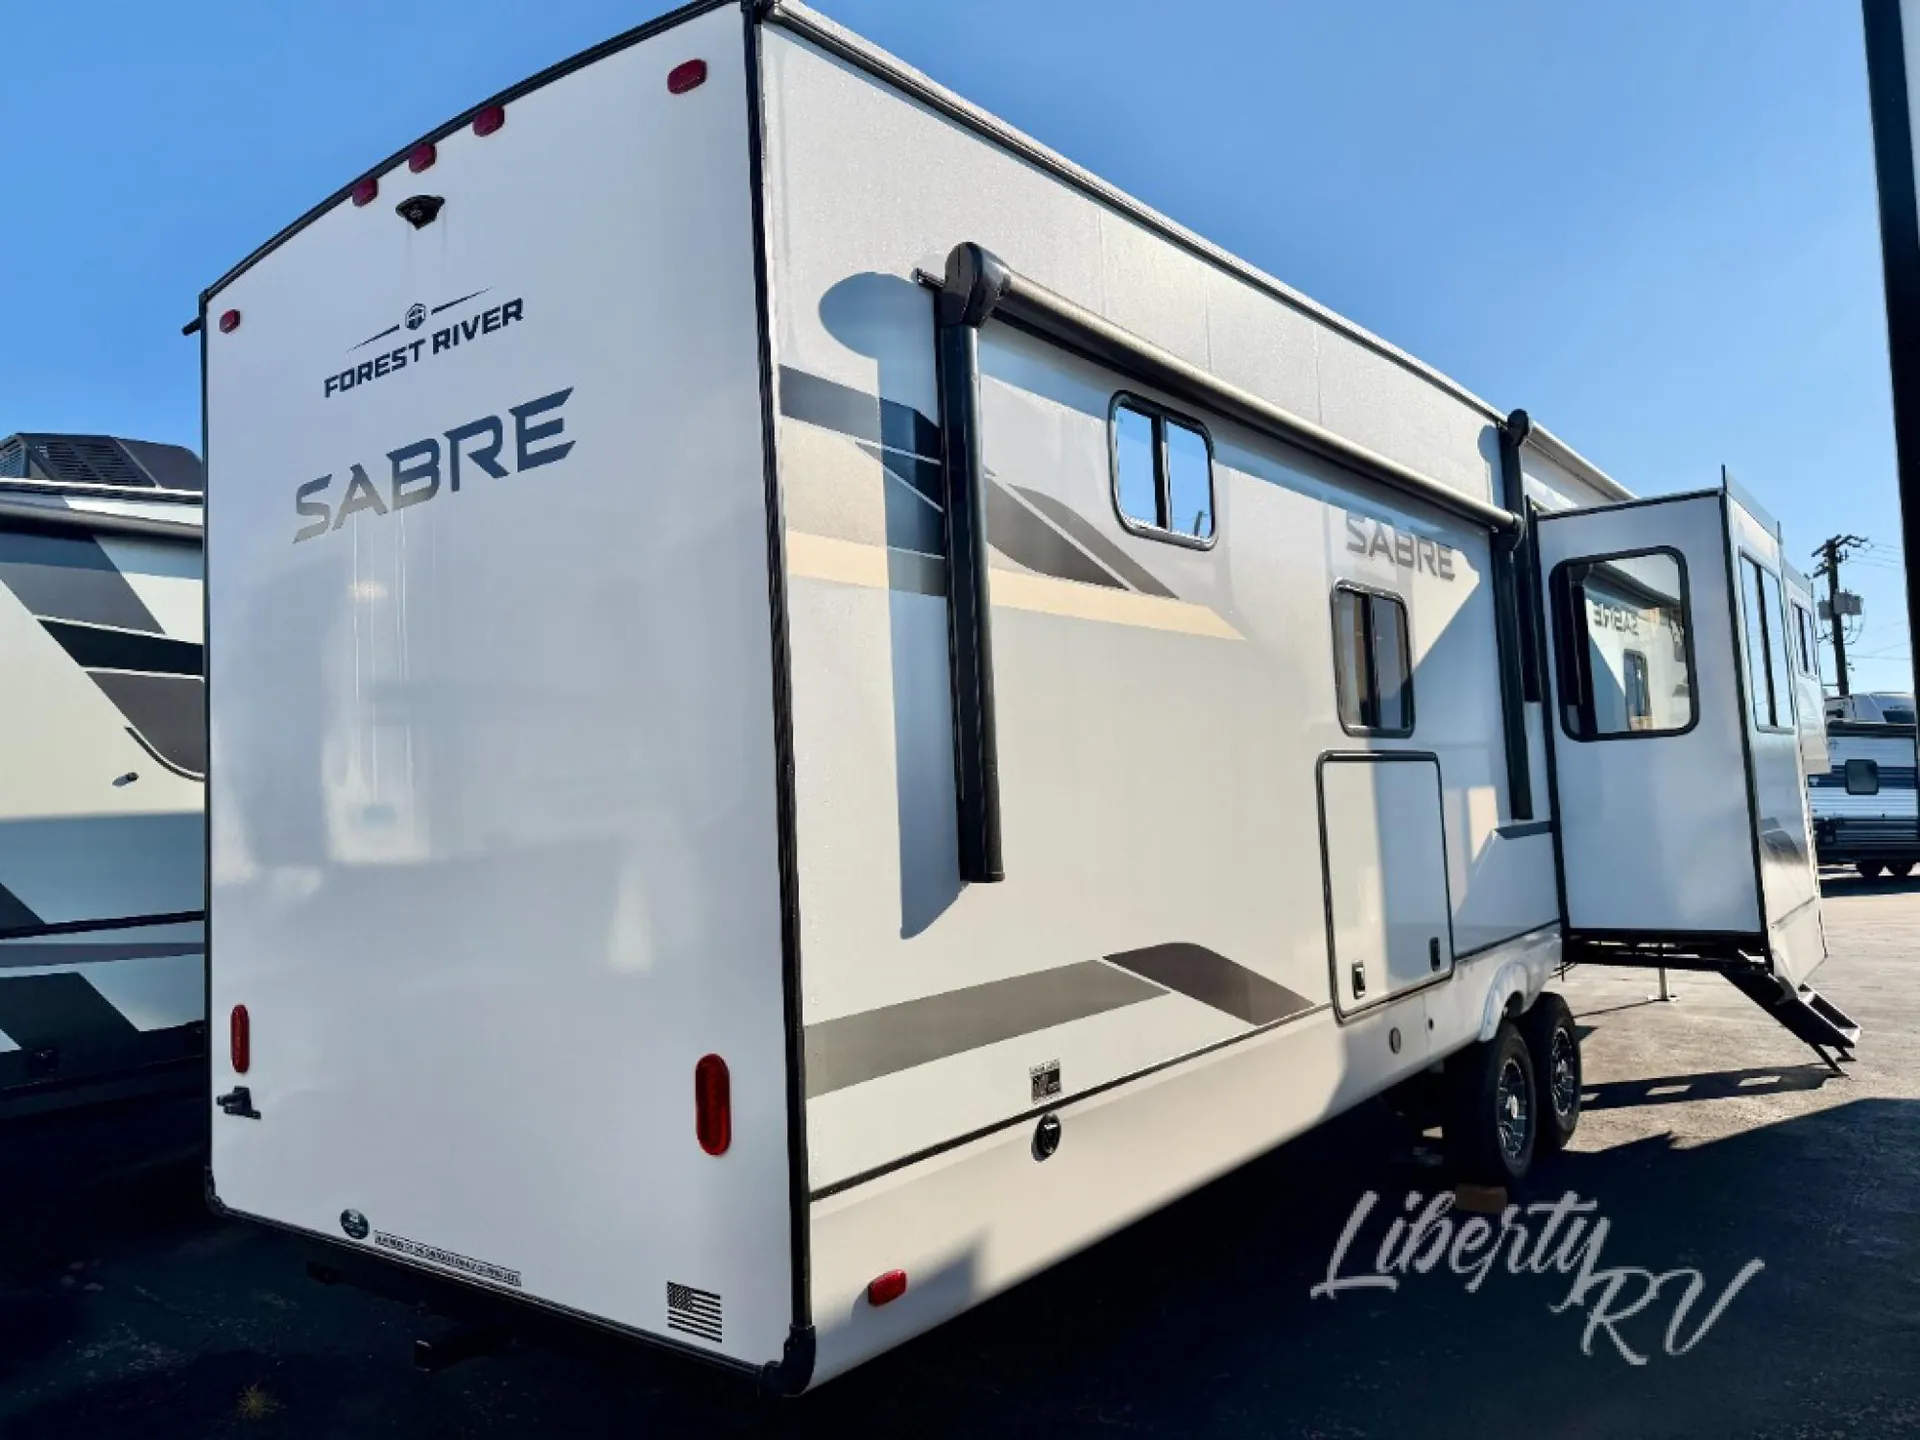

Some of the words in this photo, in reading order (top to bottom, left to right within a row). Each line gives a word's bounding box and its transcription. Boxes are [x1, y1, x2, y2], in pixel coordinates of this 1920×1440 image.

[323, 338, 427, 399] FOREST
[431, 297, 524, 355] RIVER
[292, 386, 577, 545] SABRE
[1345, 511, 1456, 581] SABRE
